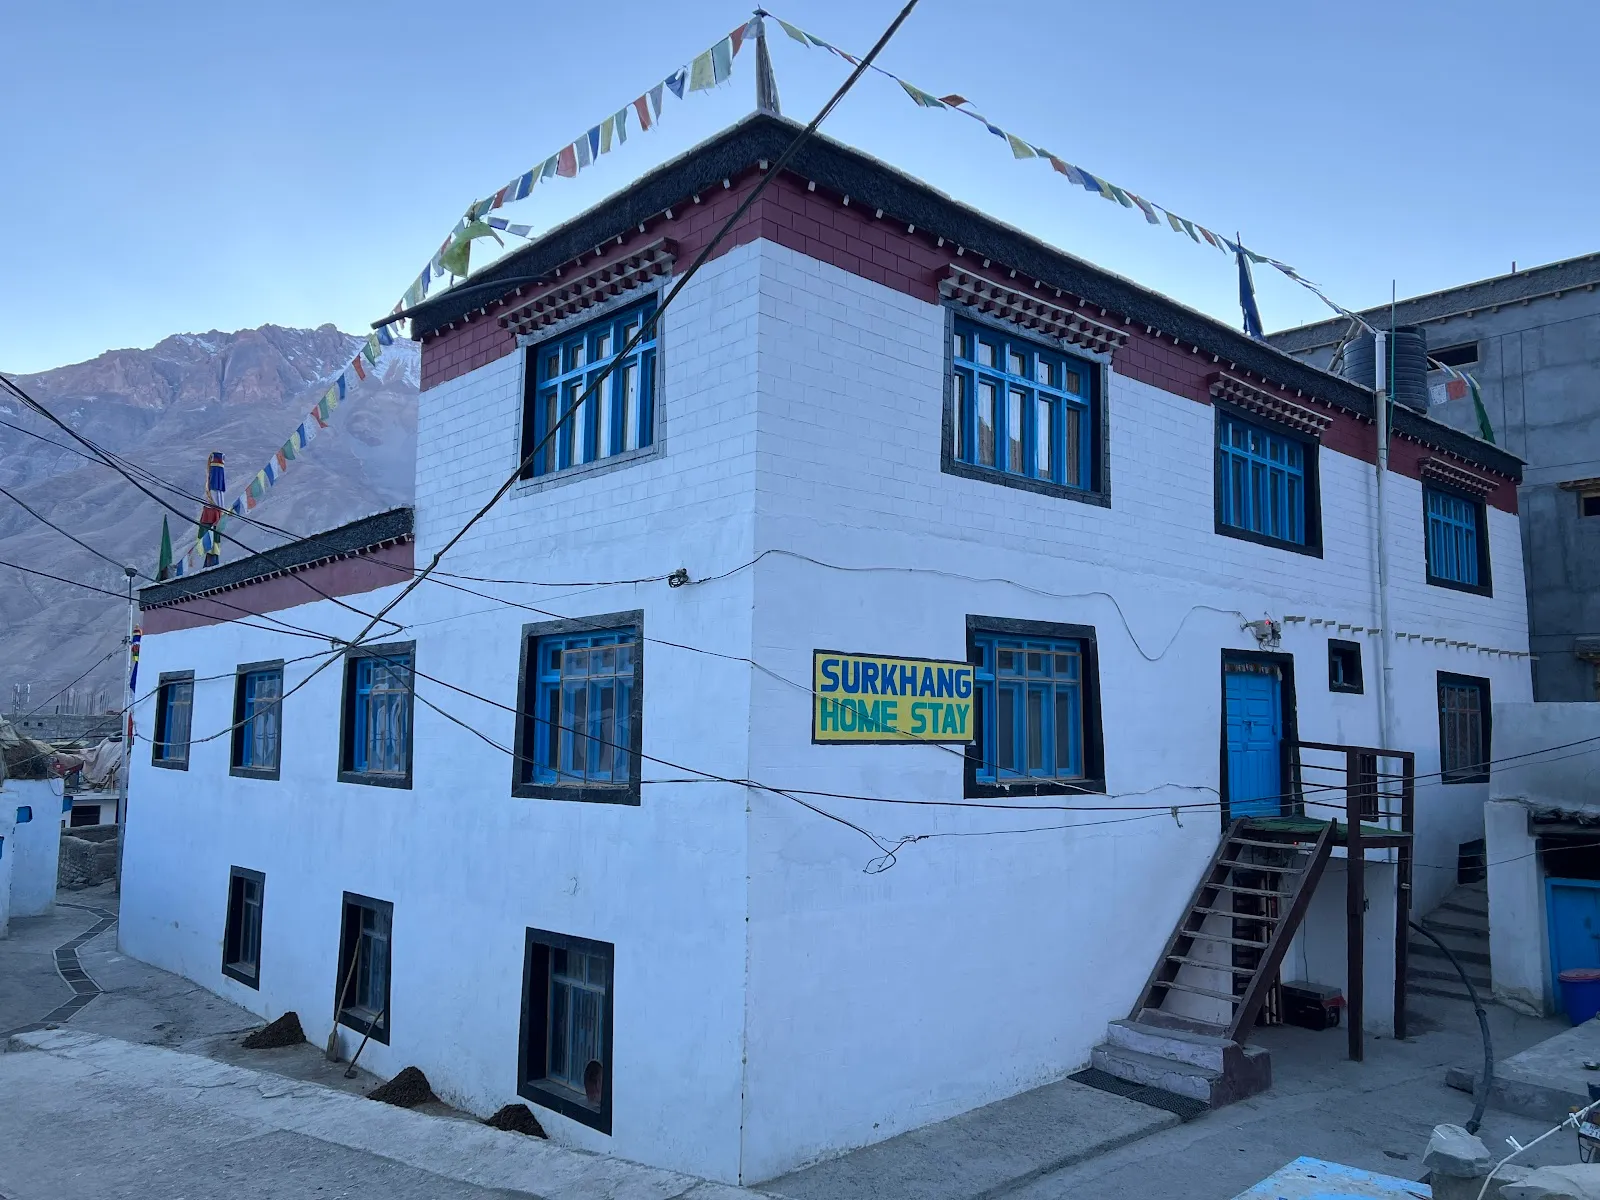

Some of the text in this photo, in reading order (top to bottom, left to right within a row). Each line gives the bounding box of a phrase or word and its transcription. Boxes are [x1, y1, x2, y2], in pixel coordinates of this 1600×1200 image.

[820, 659, 972, 699] SURKHANG
[820, 697, 970, 734] HOME STAY
